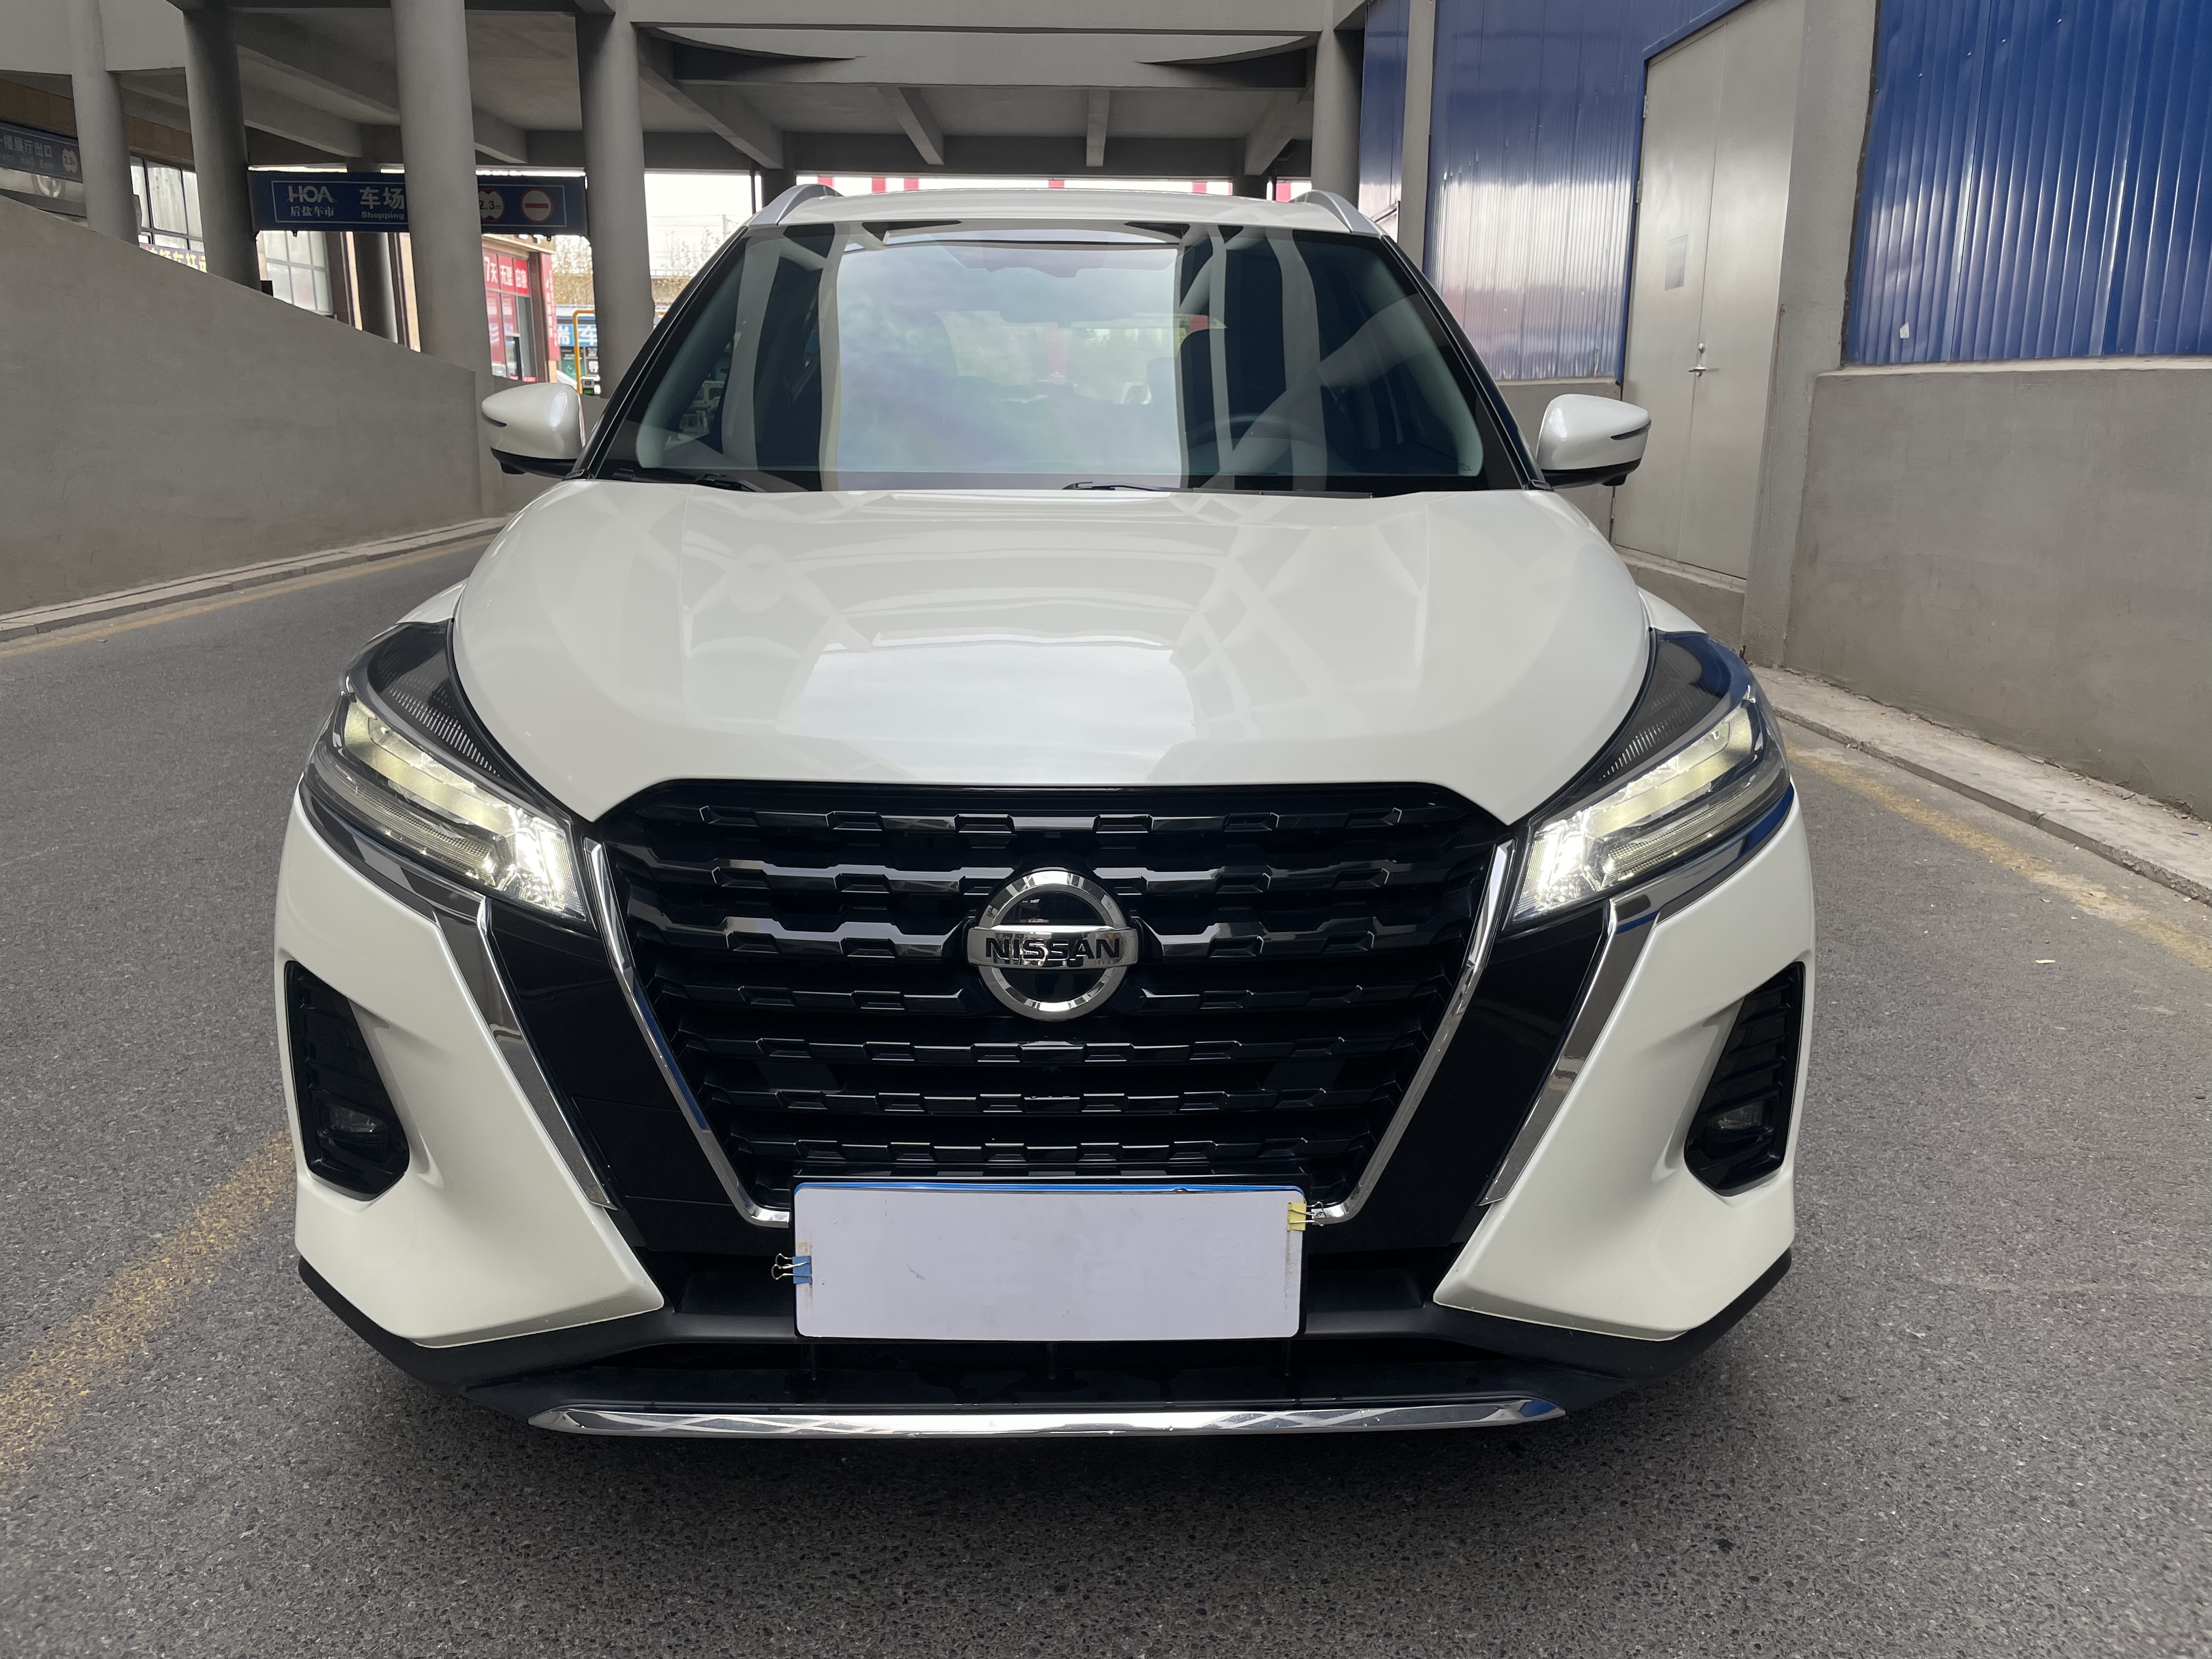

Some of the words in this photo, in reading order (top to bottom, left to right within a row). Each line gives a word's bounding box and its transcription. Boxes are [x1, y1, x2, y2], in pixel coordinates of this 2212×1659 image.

[286, 185, 335, 204] HOA
[359, 187, 405, 210] 车场
[361, 211, 405, 221] Shopping
[985, 937, 1121, 961] NISSAN
